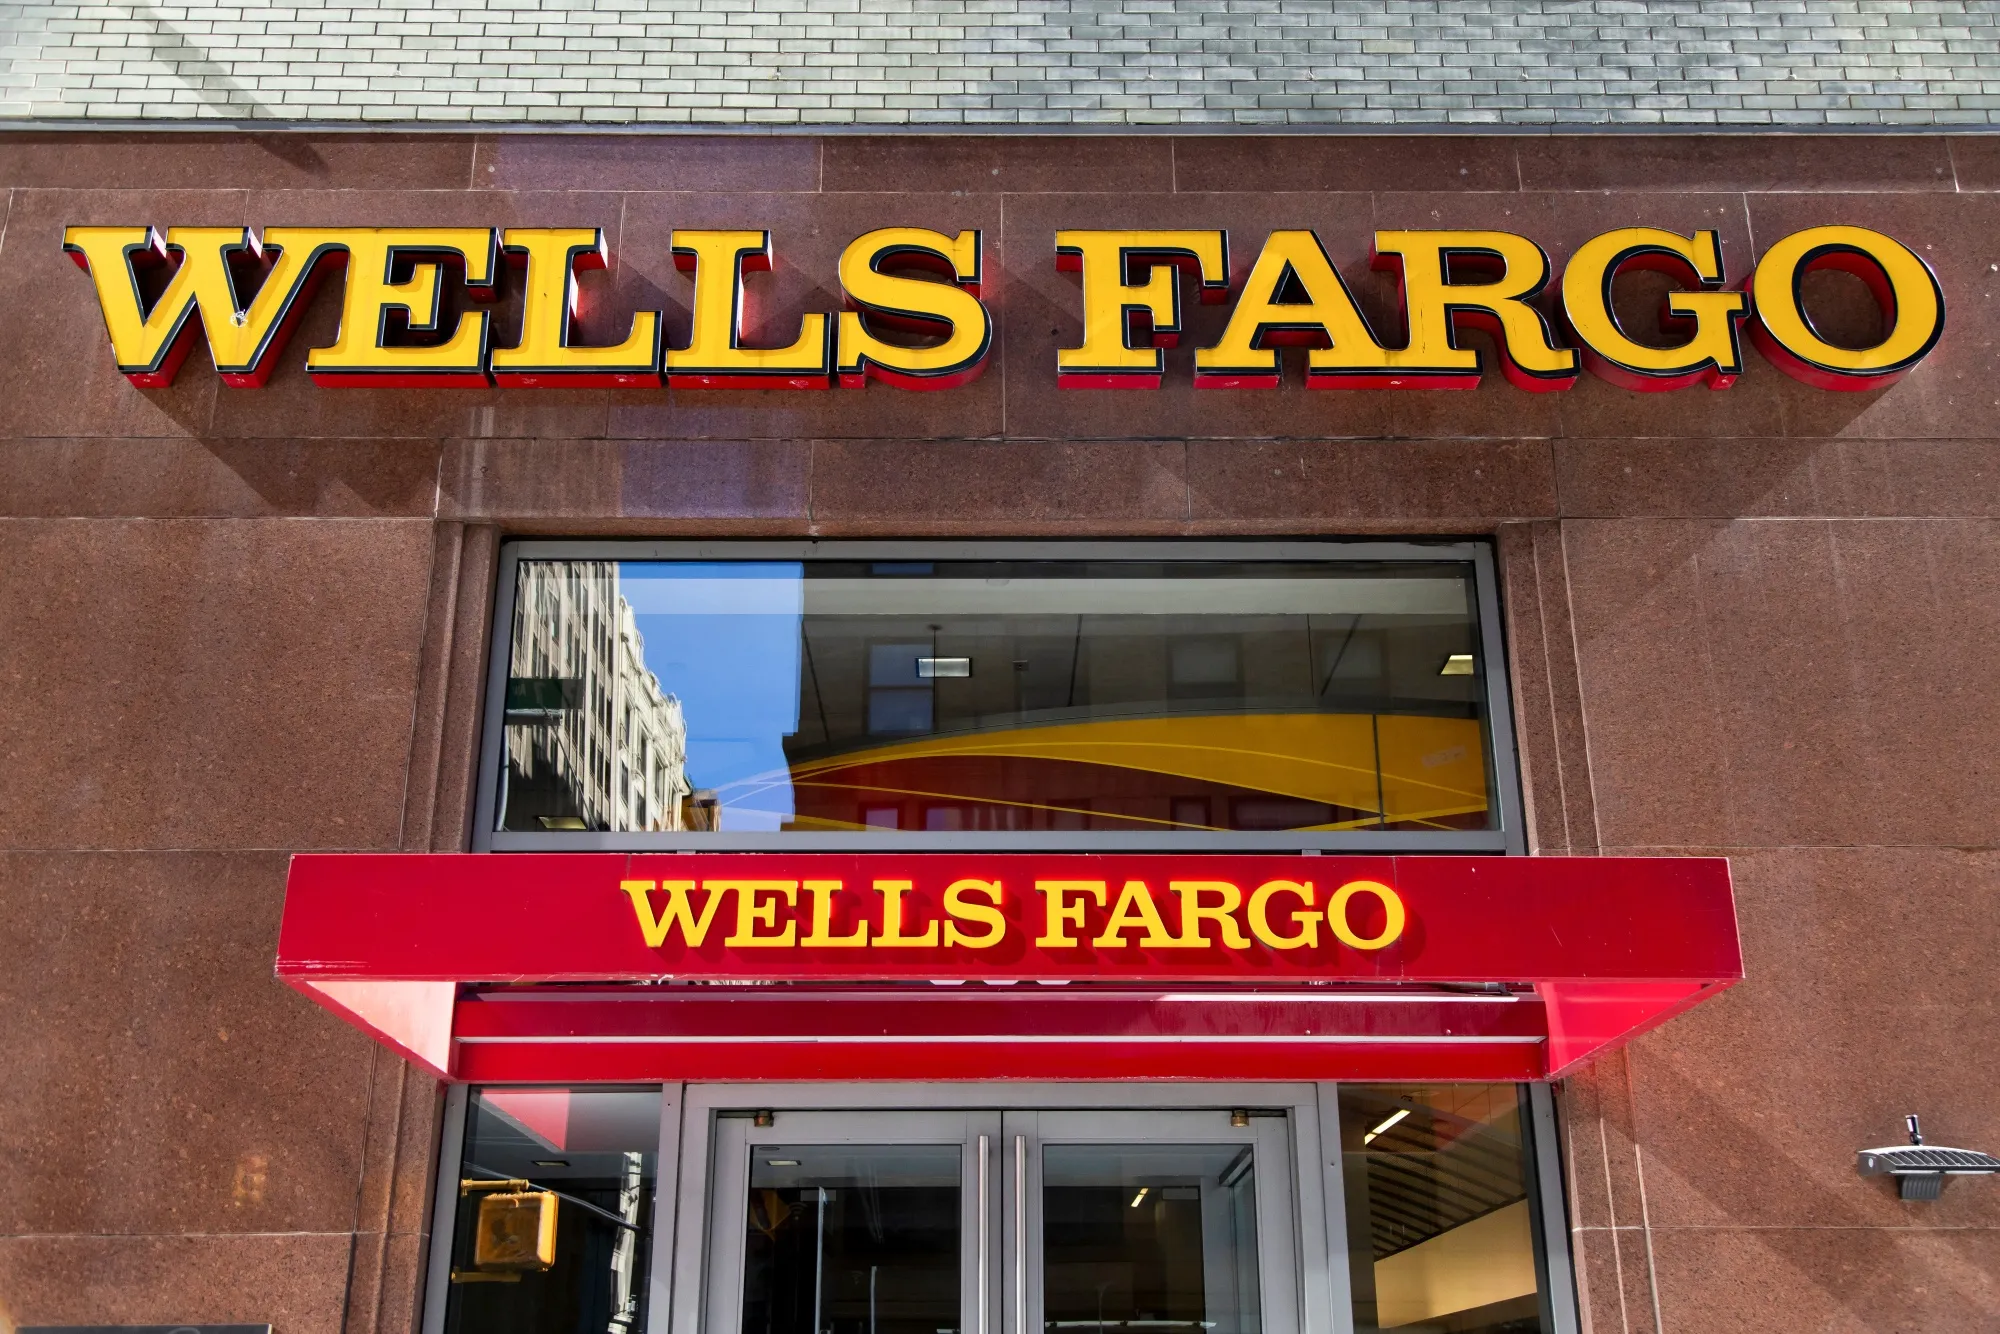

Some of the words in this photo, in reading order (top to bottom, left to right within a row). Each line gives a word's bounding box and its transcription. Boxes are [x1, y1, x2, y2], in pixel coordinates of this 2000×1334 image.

[64, 227, 992, 378] WELLS
[1054, 224, 1946, 378] FARGO
[619, 878, 1007, 949] WELLS
[1034, 879, 1406, 950] FARGO
